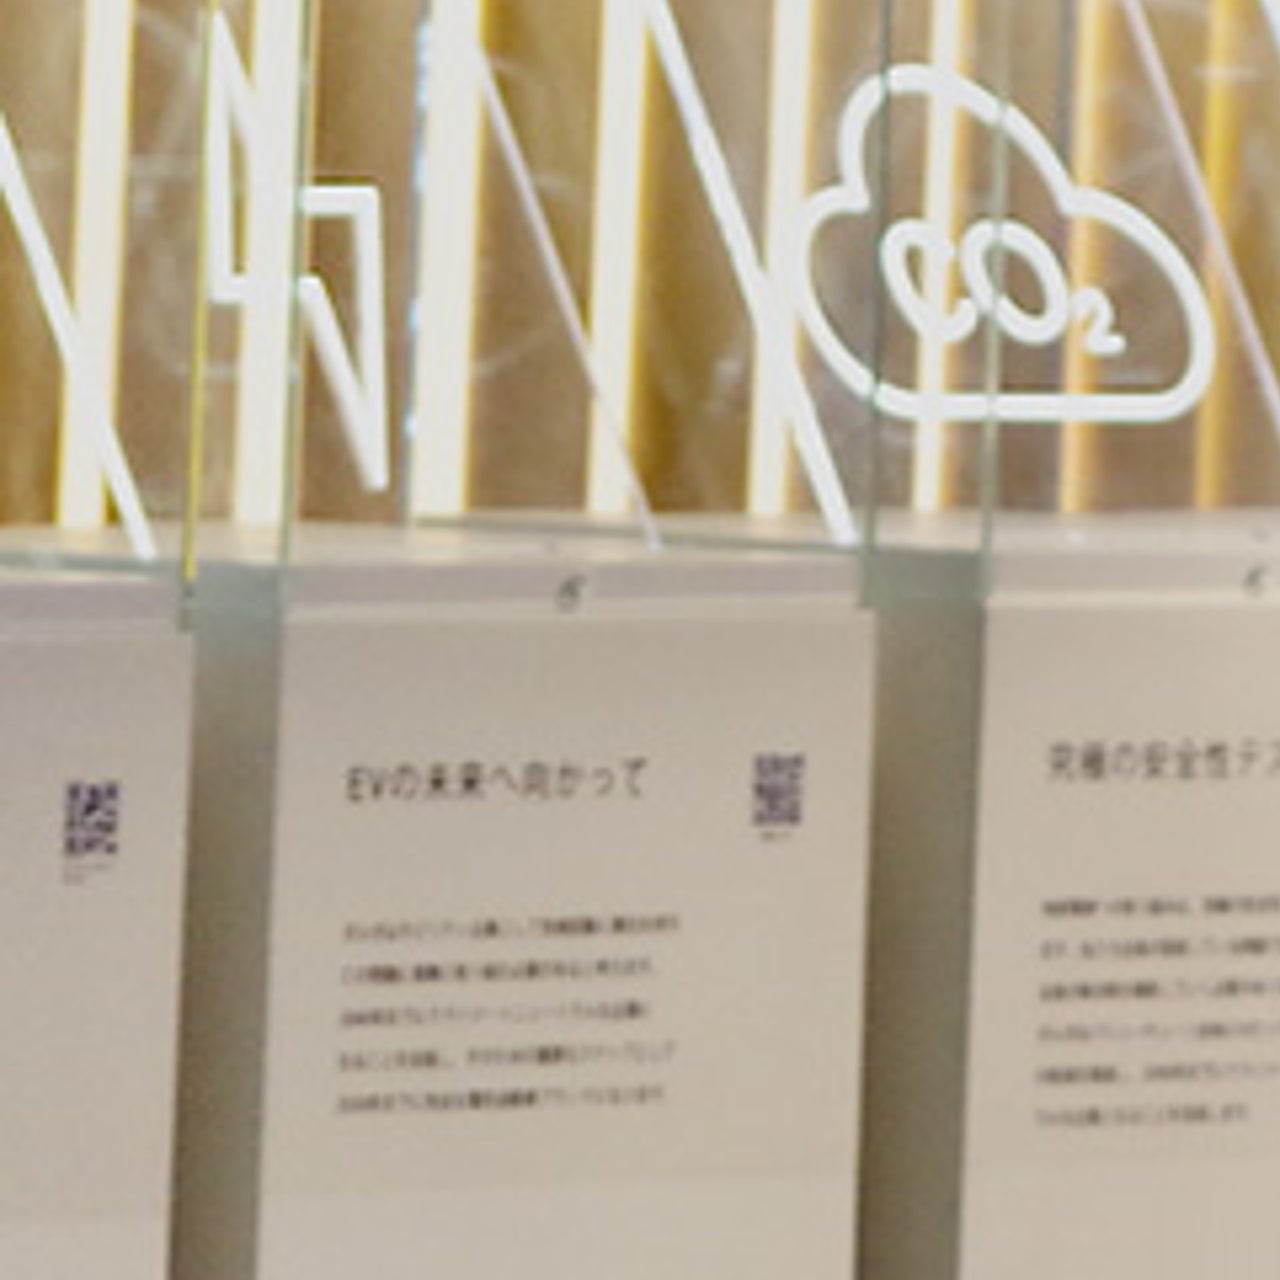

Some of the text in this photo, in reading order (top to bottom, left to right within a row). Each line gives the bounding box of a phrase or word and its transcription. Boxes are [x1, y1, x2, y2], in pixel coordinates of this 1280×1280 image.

[346, 757, 647, 803] EVの未来へ向かって
